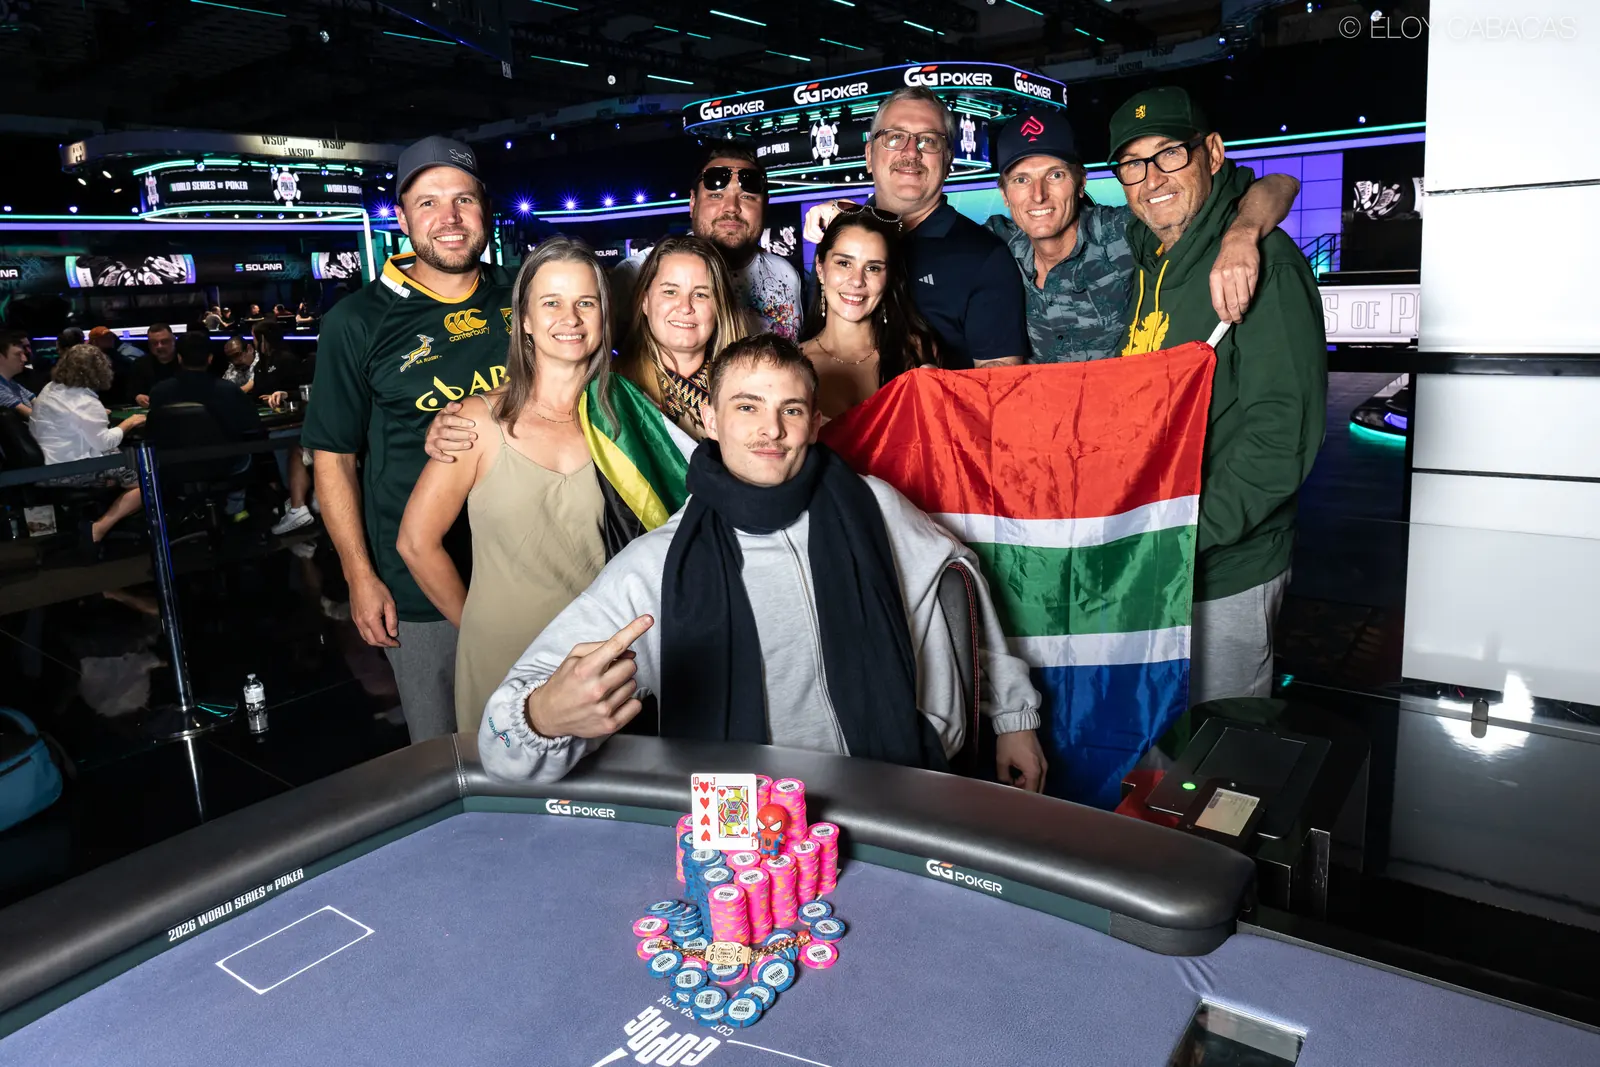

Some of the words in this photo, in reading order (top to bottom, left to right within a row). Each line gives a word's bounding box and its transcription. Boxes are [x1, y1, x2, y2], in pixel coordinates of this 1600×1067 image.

[261, 135, 288, 146] WSOP
[321, 139, 346, 150] WSOP
[288, 147, 314, 158] WSOP
[171, 181, 191, 192] WORLD
[191, 180, 216, 191] SERIES
[225, 180, 248, 190] POKER
[326, 184, 347, 193] WORLD
[245, 263, 283, 272] SOLANA
[1351, 300, 1380, 330] OF
[449, 326, 490, 343] canterbury
[692, 776, 700, 786] 10
[710, 776, 716, 786] J
[167, 919, 197, 942] 2026
[197, 901, 233, 927] WORLD
[234, 885, 266, 910] SERIES
[266, 883, 273, 892] OF
[274, 868, 304, 890] POKER
[623, 1005, 721, 1067] COPAG
